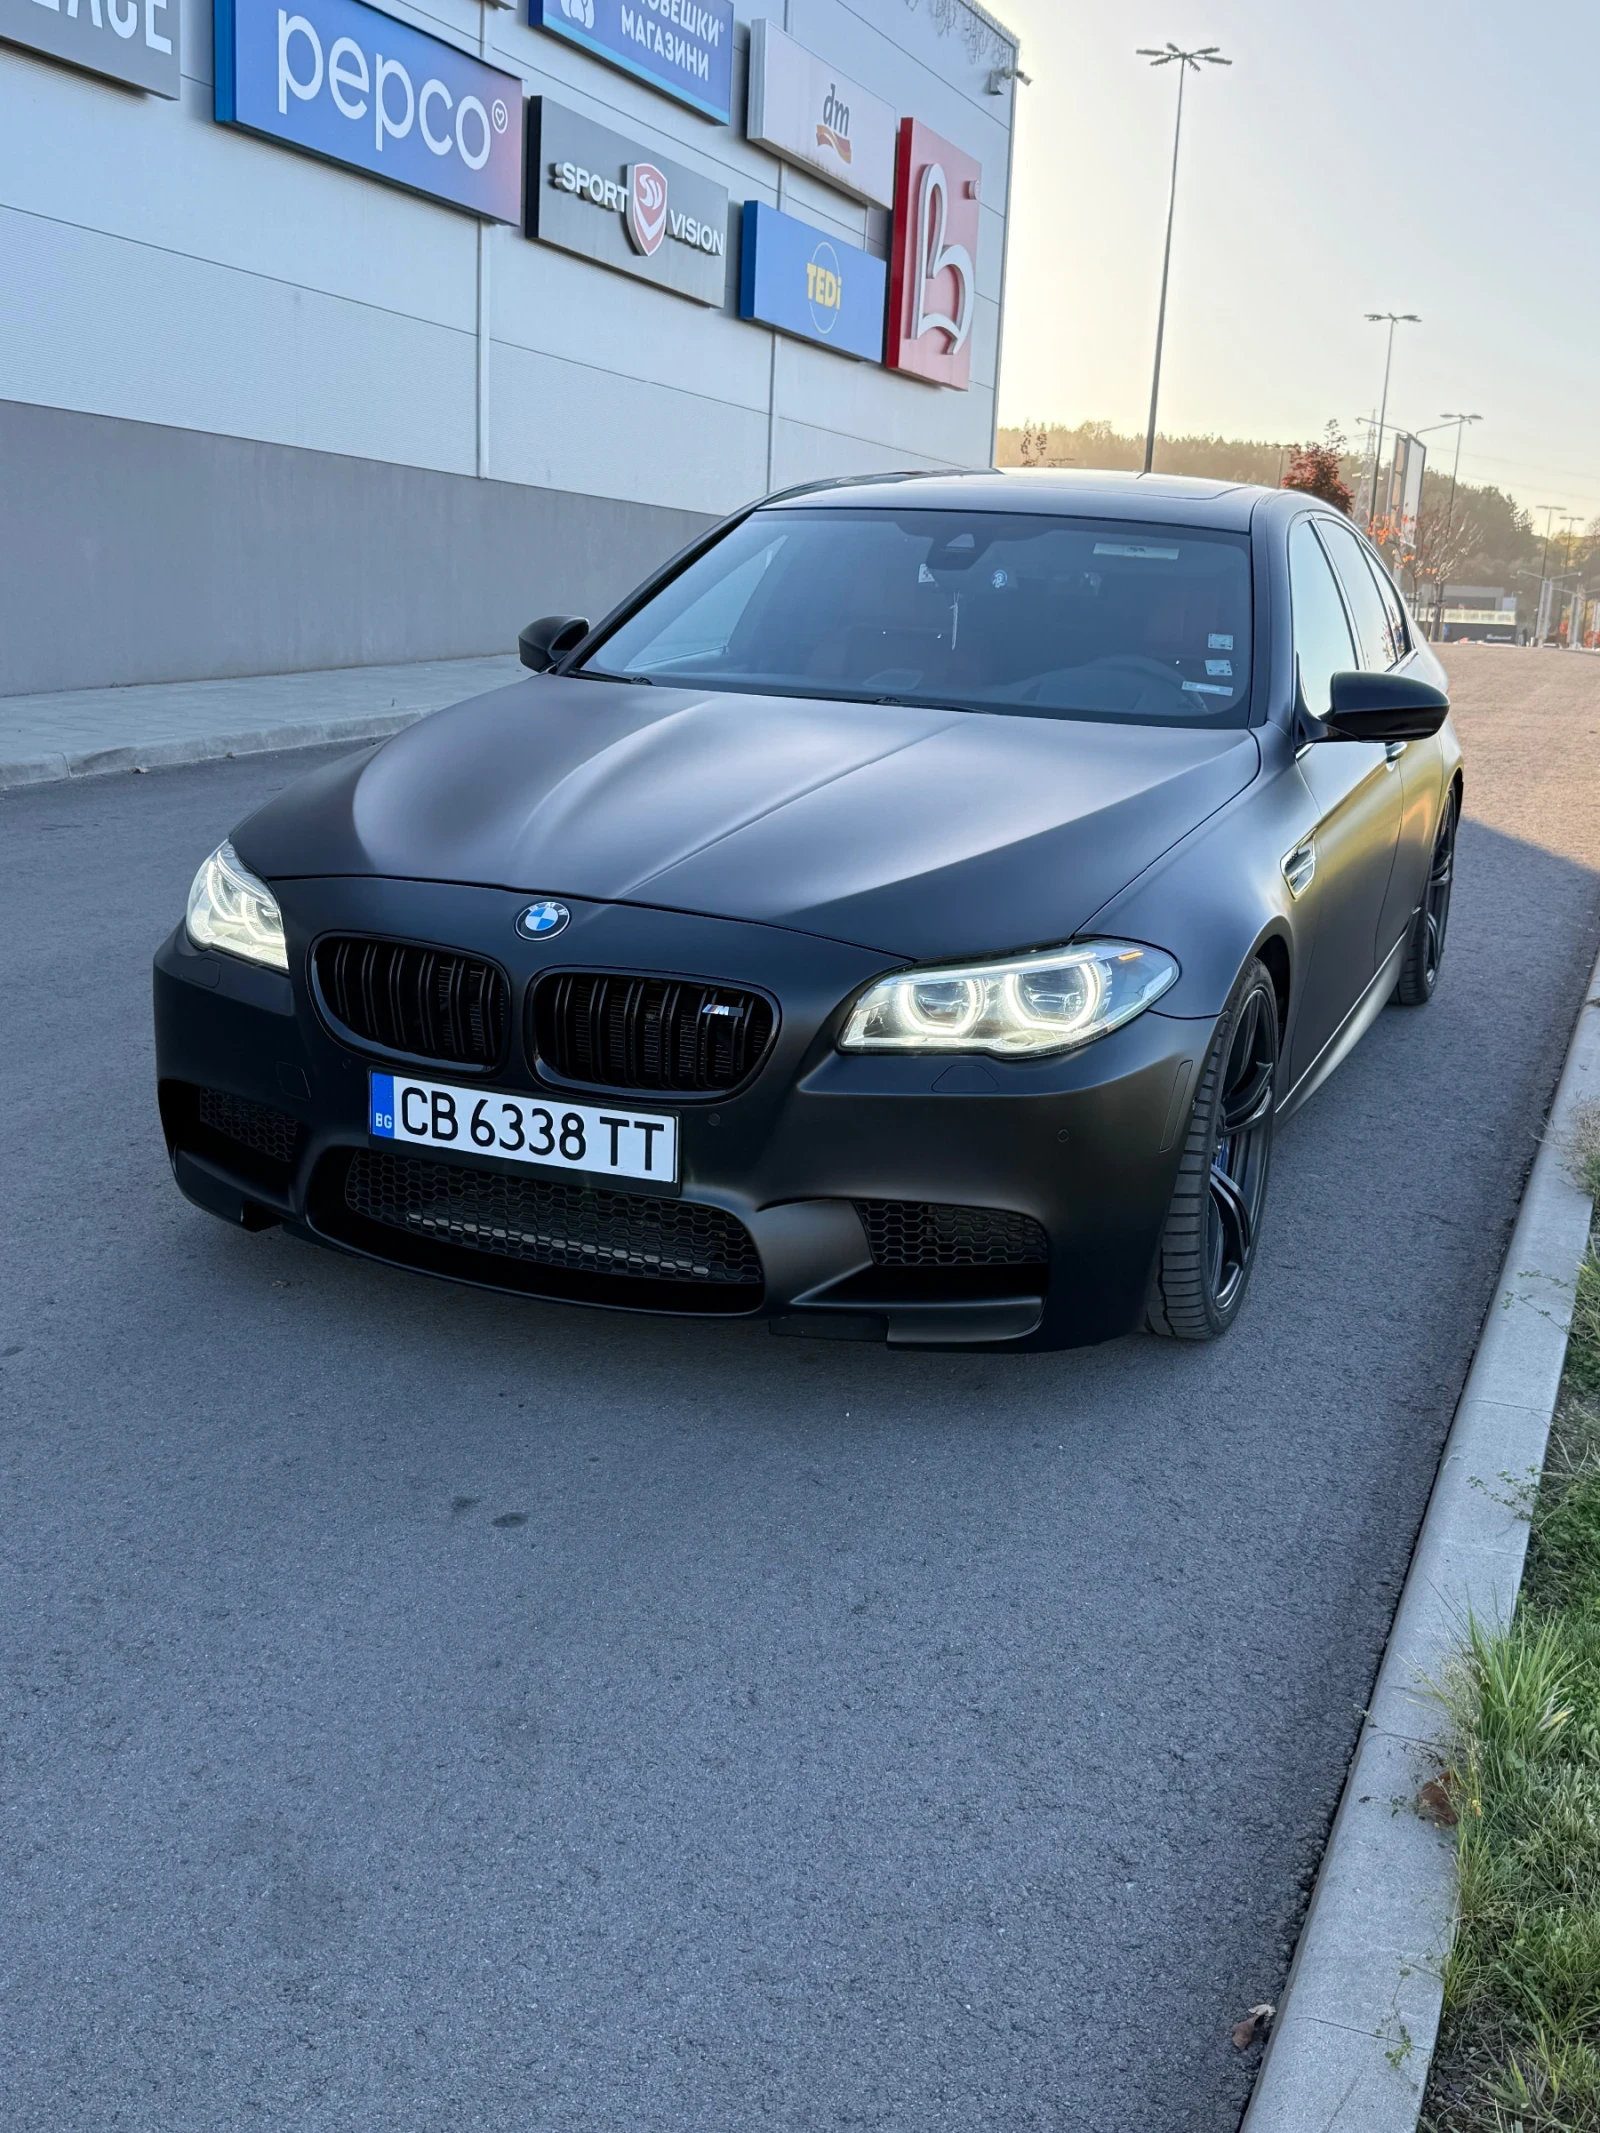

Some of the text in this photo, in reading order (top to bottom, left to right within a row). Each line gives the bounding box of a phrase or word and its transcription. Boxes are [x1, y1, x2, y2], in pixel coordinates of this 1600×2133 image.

[621, 4, 709, 82] МАГАЗИНИ
[278, 8, 491, 171] pepco
[823, 83, 850, 137] dm
[559, 162, 630, 213] SPORT
[669, 209, 724, 256] VISION
[806, 262, 842, 310] TEDi
[375, 1112, 393, 1130] BG
[401, 1086, 665, 1172] CB 6338 TT
